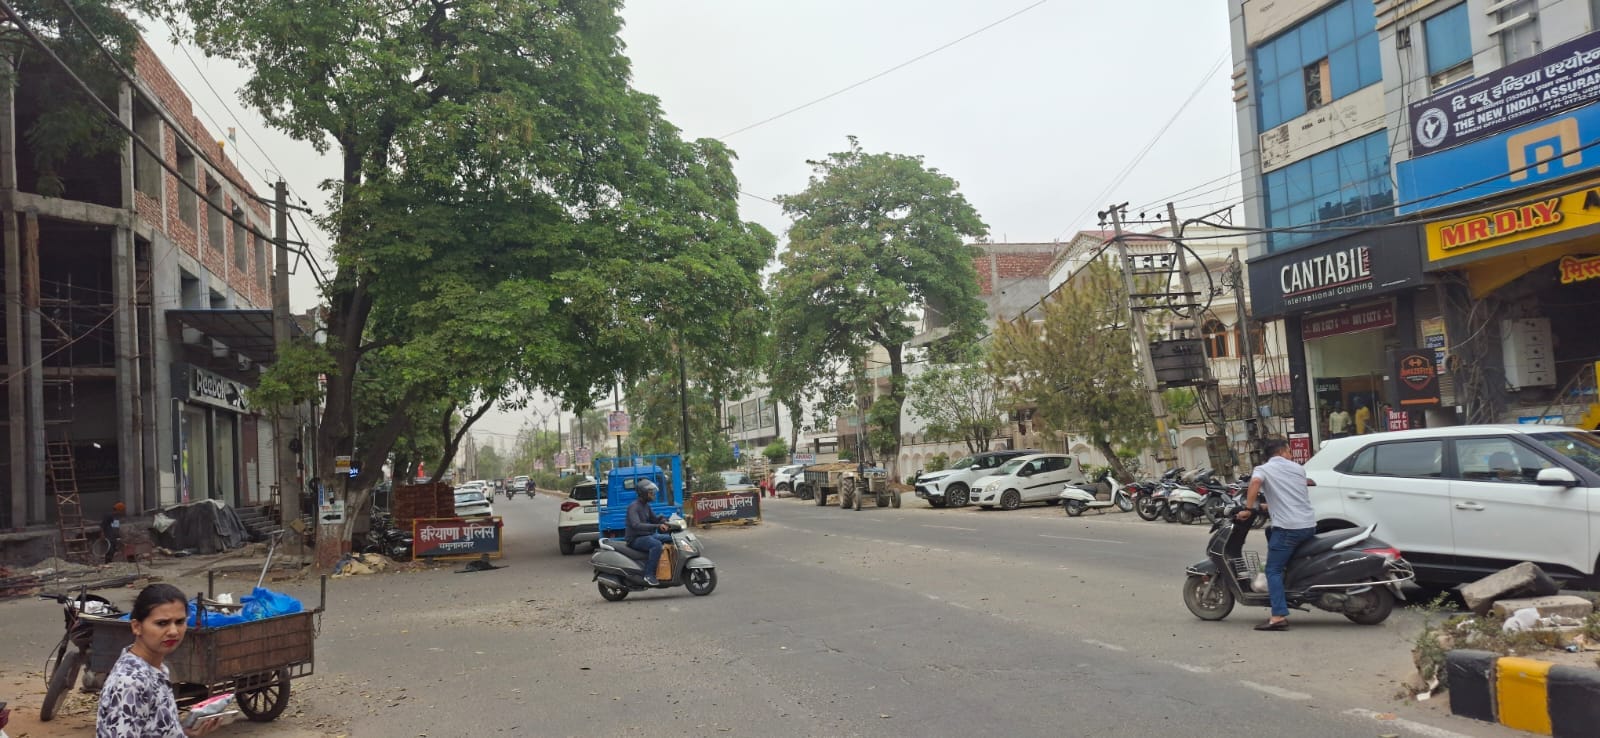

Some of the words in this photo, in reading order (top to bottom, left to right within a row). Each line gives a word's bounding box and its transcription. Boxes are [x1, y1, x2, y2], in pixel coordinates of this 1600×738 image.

[1452, 95, 1467, 112] दि
[1453, 116, 1475, 131] THE
[1477, 106, 1503, 124] NEW
[1506, 94, 1540, 114] INDIA
[1281, 246, 1370, 294] CANTABIL
[1284, 289, 1335, 306] International
[1337, 282, 1373, 296] Clothing
[196, 368, 226, 400] Reebok
[695, 497, 728, 511] हरियाणा
[729, 495, 753, 509] पुलिस
[420, 525, 460, 542] हरियाणा
[462, 523, 495, 541] पुलिस
[439, 541, 475, 551] यमुनानगर
